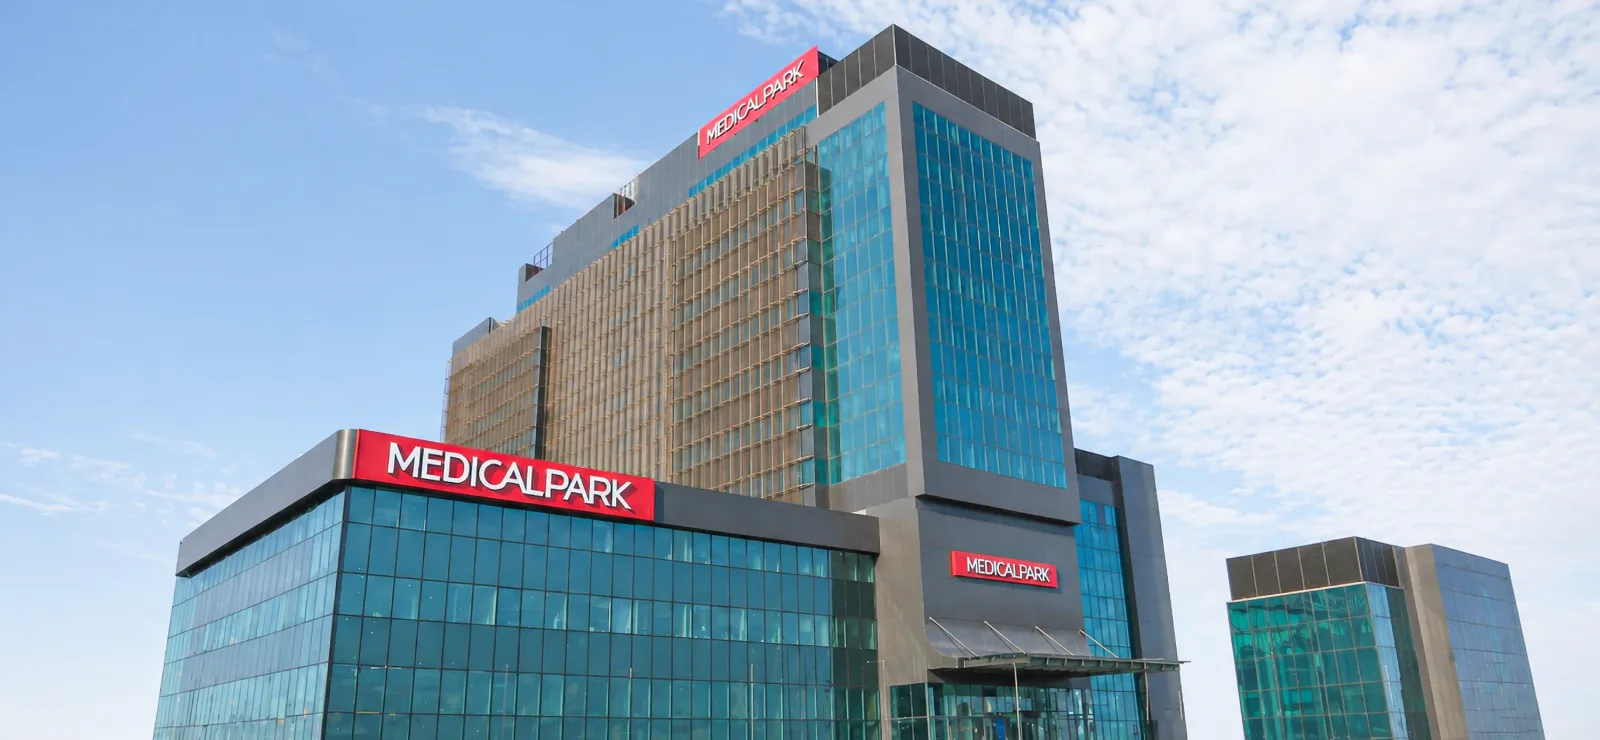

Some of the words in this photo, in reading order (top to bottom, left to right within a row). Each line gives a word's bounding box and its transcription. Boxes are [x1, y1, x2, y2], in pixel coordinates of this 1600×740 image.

[706, 60, 804, 144] MEDICALPARK
[387, 442, 632, 510] MEDICALPARK
[966, 556, 1050, 582] MEDICALPARK
